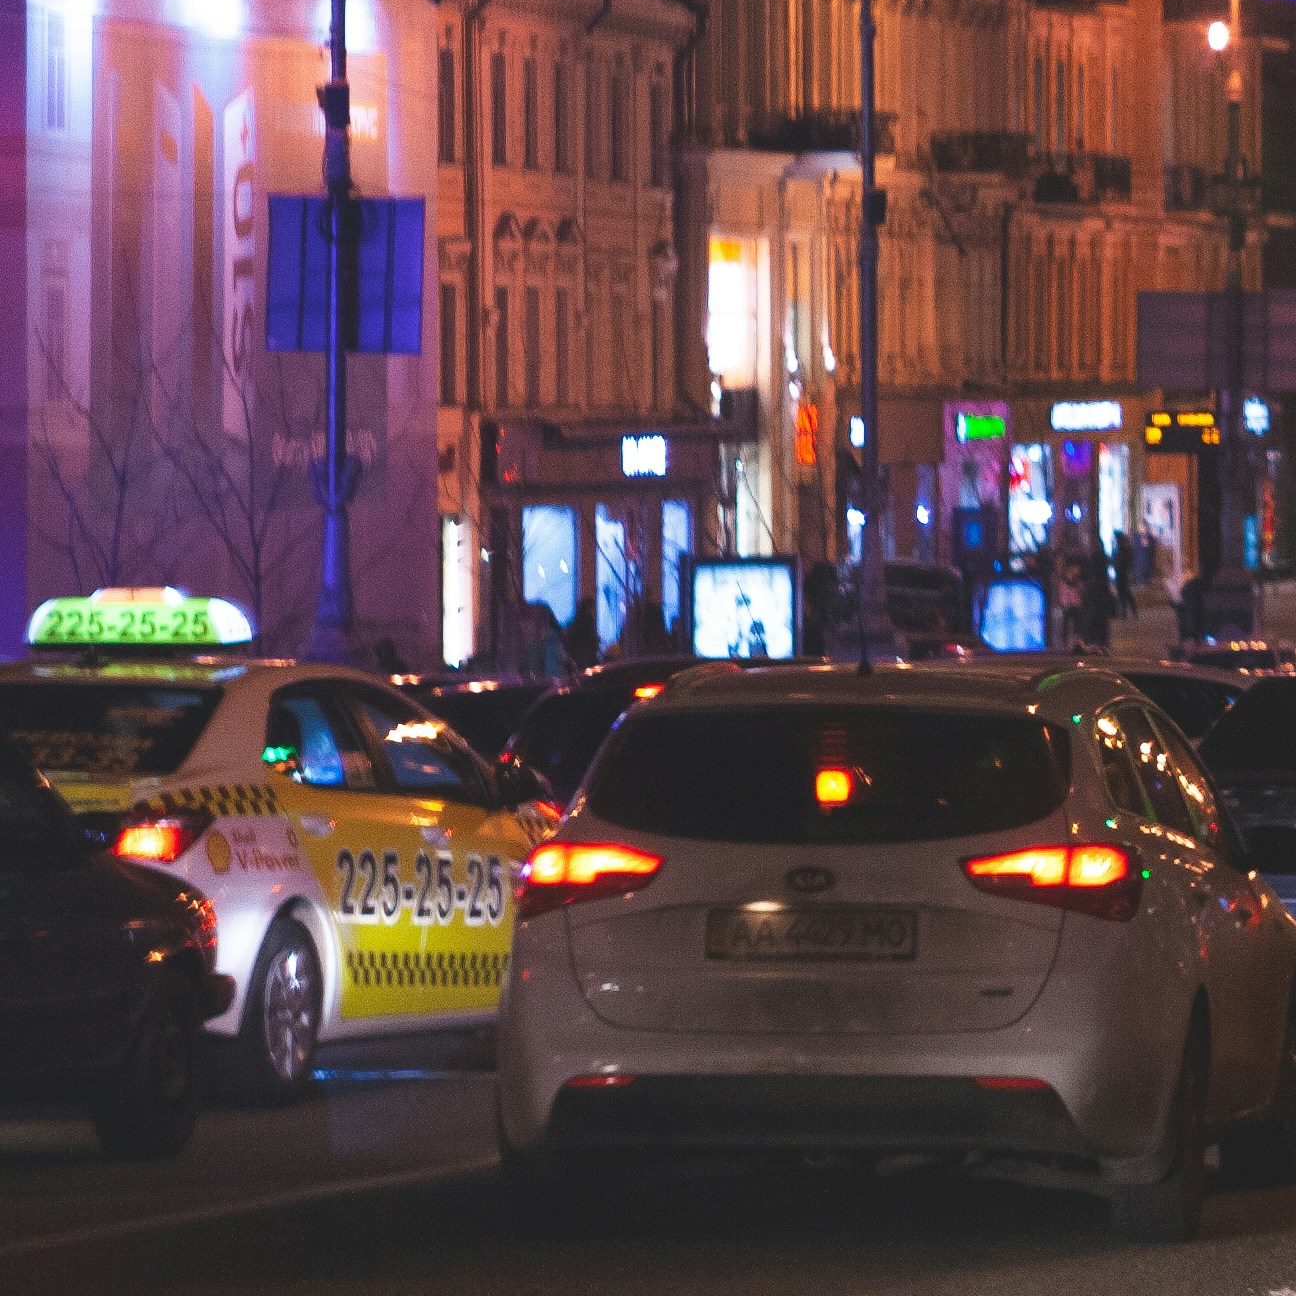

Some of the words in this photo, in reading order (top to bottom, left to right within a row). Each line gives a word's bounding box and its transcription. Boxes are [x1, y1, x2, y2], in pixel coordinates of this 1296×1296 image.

[47, 609, 209, 639] 225-25-25
[335, 847, 505, 924] 225-25-25
[731, 918, 776, 947] AA
